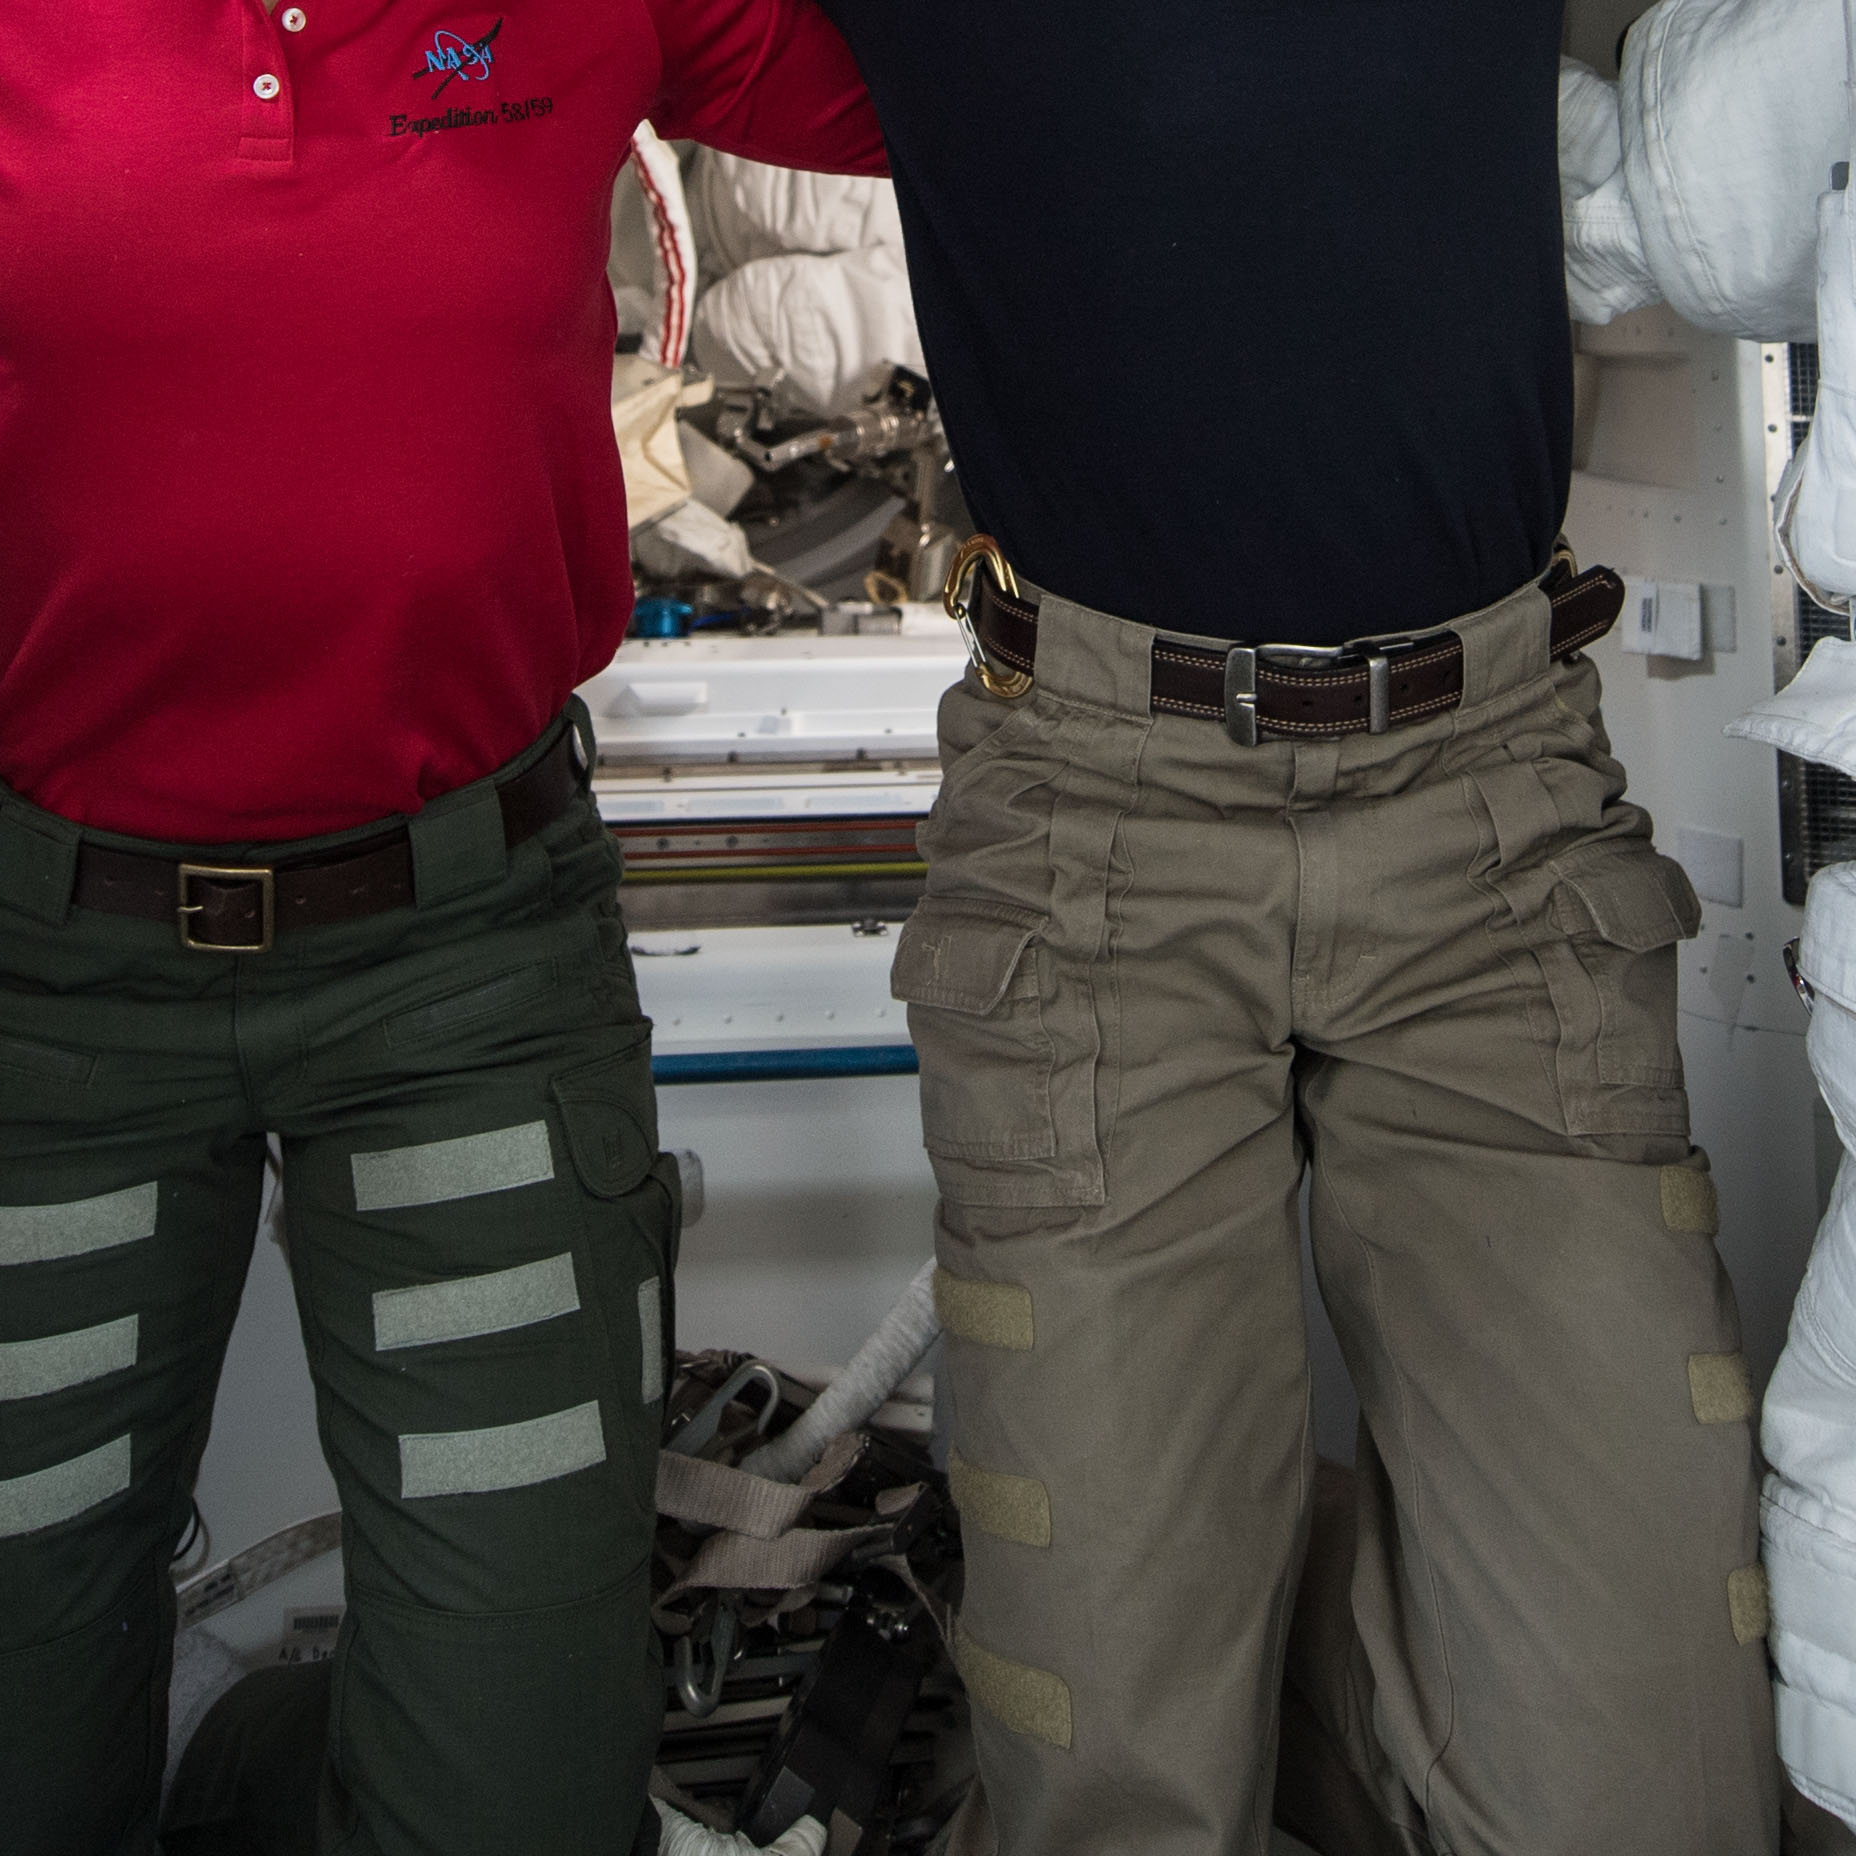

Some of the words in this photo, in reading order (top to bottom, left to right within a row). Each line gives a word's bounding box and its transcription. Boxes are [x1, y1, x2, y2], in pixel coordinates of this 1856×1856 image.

[424, 42, 495, 76] NASA
[388, 106, 499, 138] Expedition
[500, 97, 554, 123] 58/59
